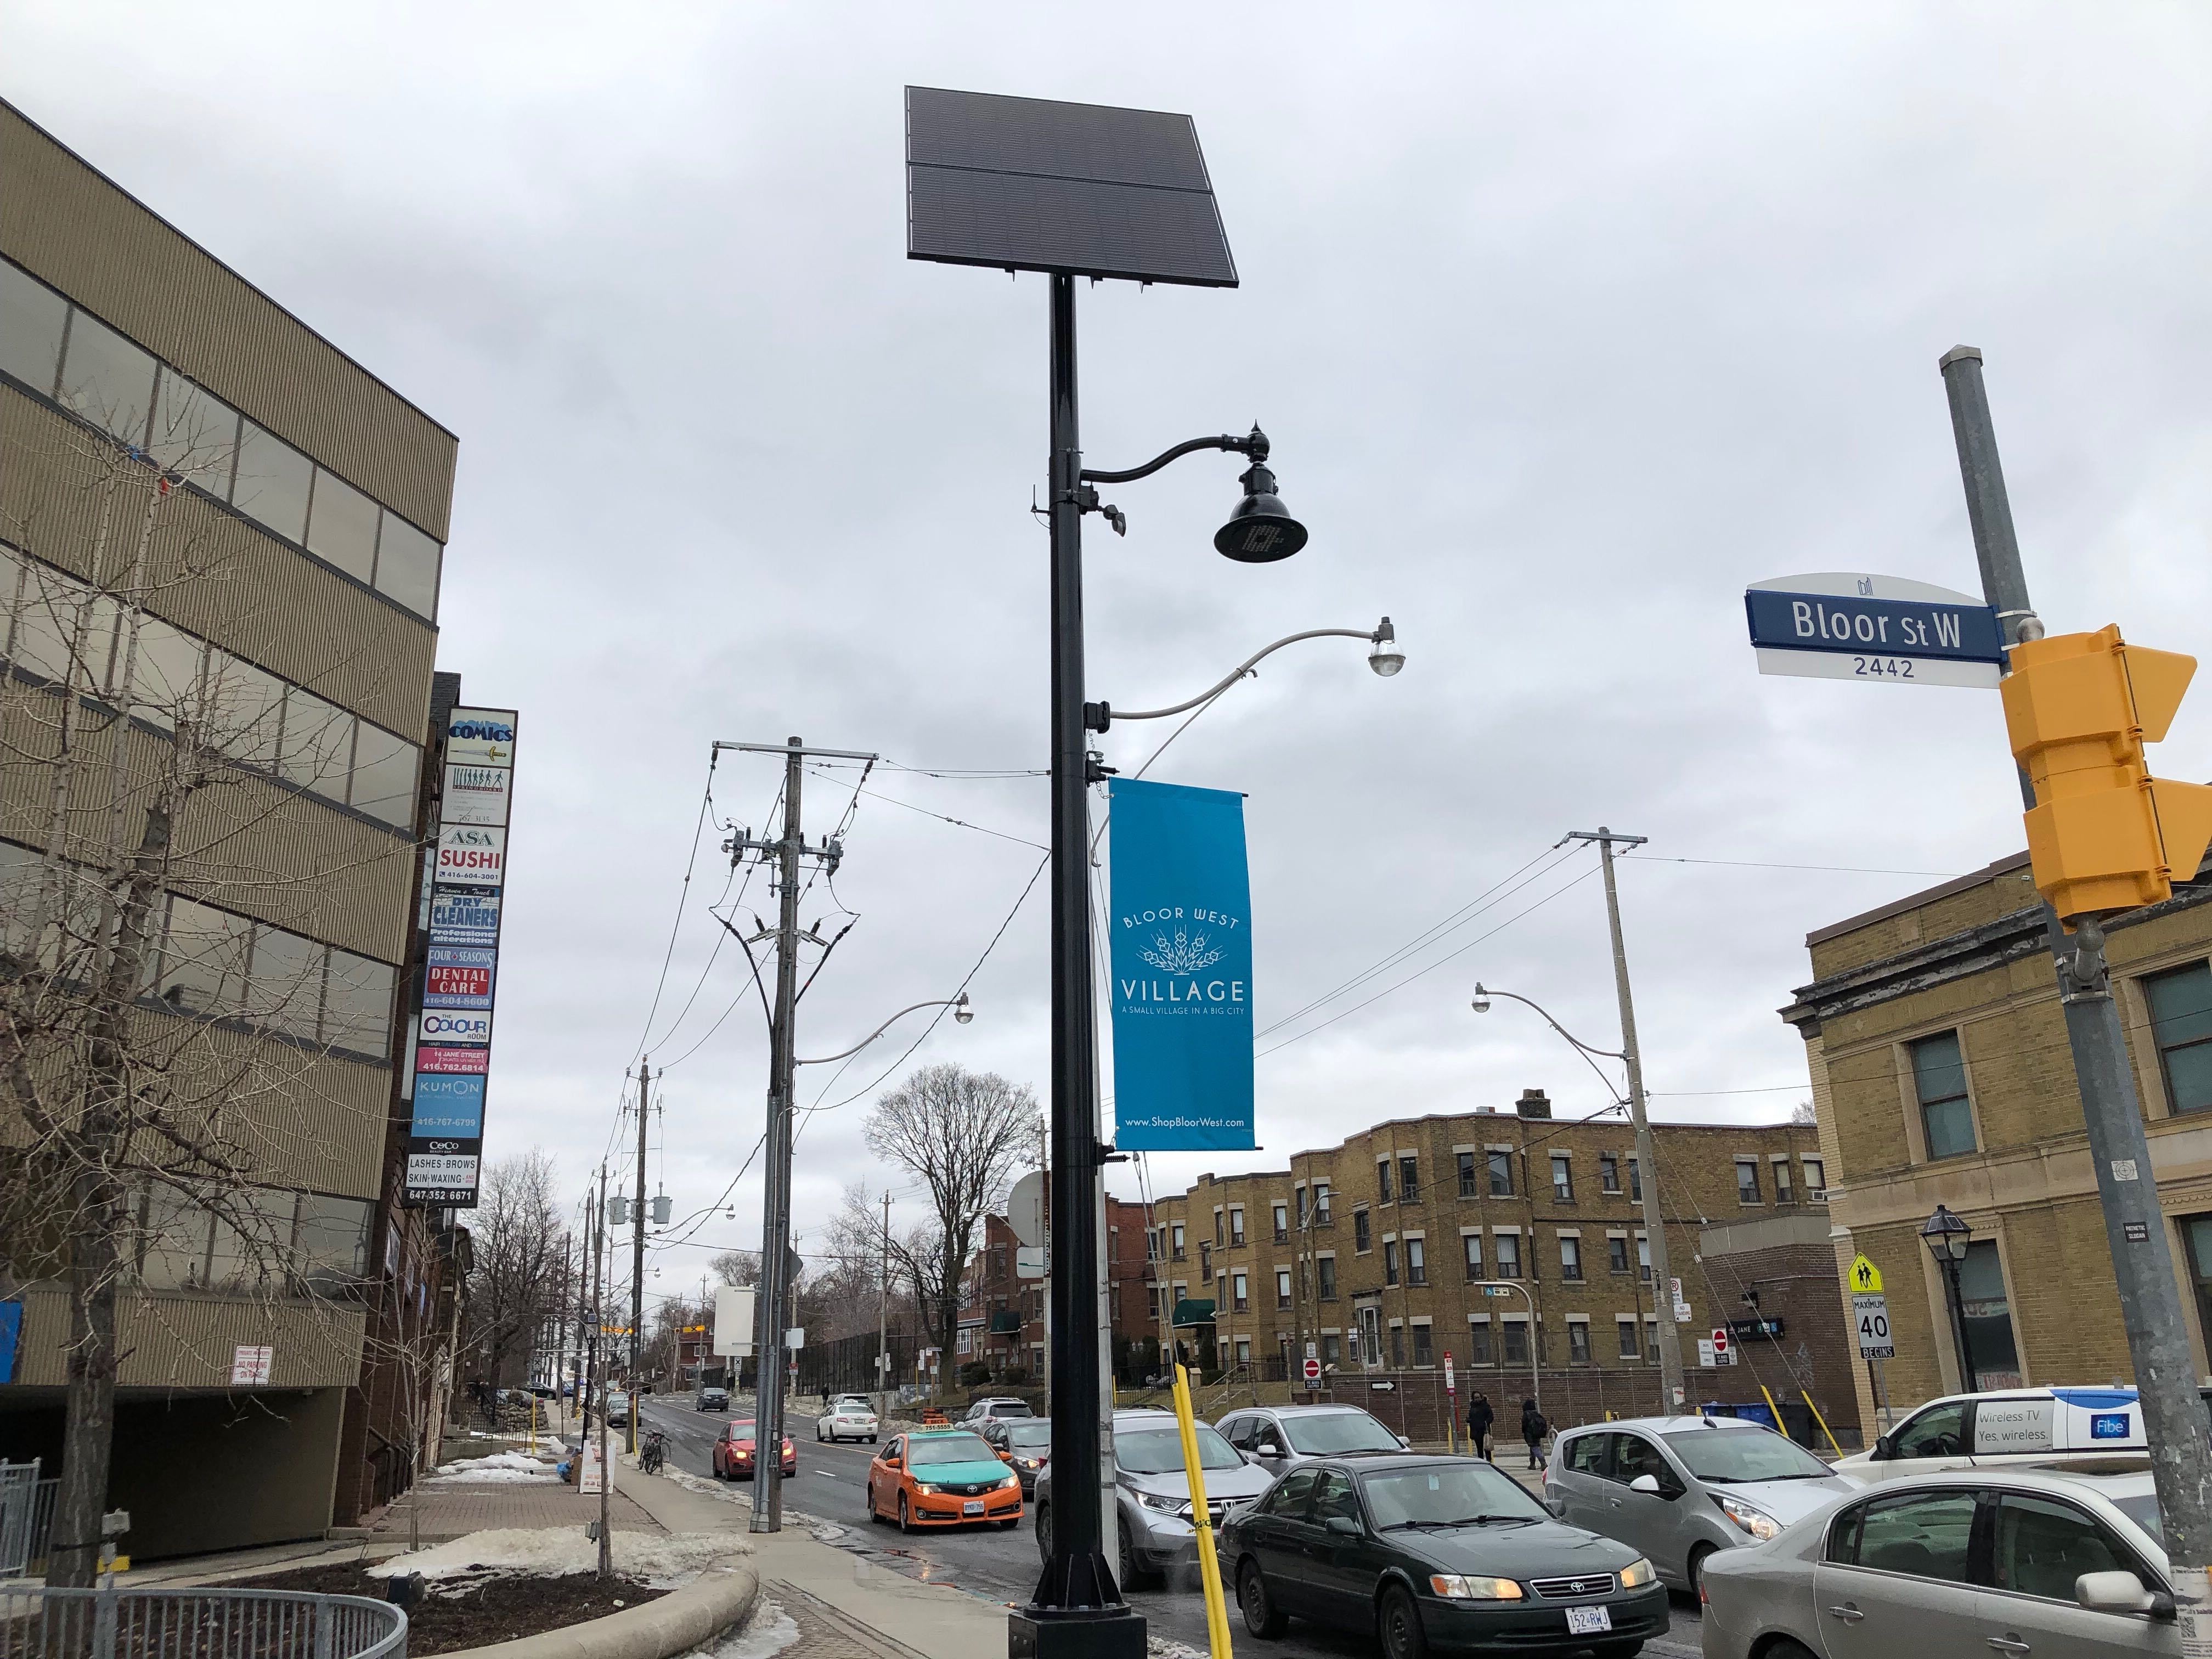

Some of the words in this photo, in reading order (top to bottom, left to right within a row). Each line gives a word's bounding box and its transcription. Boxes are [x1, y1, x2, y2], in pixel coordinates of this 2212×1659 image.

[1792, 601, 1888, 642] Bloor
[1901, 617, 1929, 646] St
[1932, 612, 1960, 648] W
[1853, 657, 1914, 678] 2442
[449, 720, 513, 742] COMICS
[449, 830, 494, 847] ASA
[439, 849, 500, 869] SUSHI
[447, 872, 498, 880] 416-604-3001
[453, 897, 482, 907] DRY
[433, 906, 498, 928] CLEANERS
[1122, 907, 1184, 928] BLOOR
[1194, 908, 1239, 929] WEST
[430, 929, 497, 938] Professional
[433, 936, 493, 944] alterations
[428, 950, 451, 965] FOUR
[459, 951, 493, 968] SEASONS
[431, 968, 488, 981] DENTAL
[439, 981, 477, 994] CARE
[1121, 979, 1244, 1002] VILLAGE
[1129, 1006, 1154, 1014] SMALL
[420, 1080, 479, 1095] KUMON
[1125, 1116, 1245, 1129] www.ShopBloorWest.com
[410, 1159, 442, 1168] LASHES
[446, 1160, 475, 1169] BROWS
[408, 1173, 427, 1183] SKIN
[431, 1174, 462, 1183] WAXING
[1854, 1300, 1885, 1310] MAXIMUM
[1860, 1315, 1888, 1338] 40
[1863, 1346, 1893, 1358] BEGINS
[1979, 1412, 2023, 1424] Wireless
[1978, 1431, 1999, 1442] Yes,
[2001, 1430, 2049, 1441] wireless.
